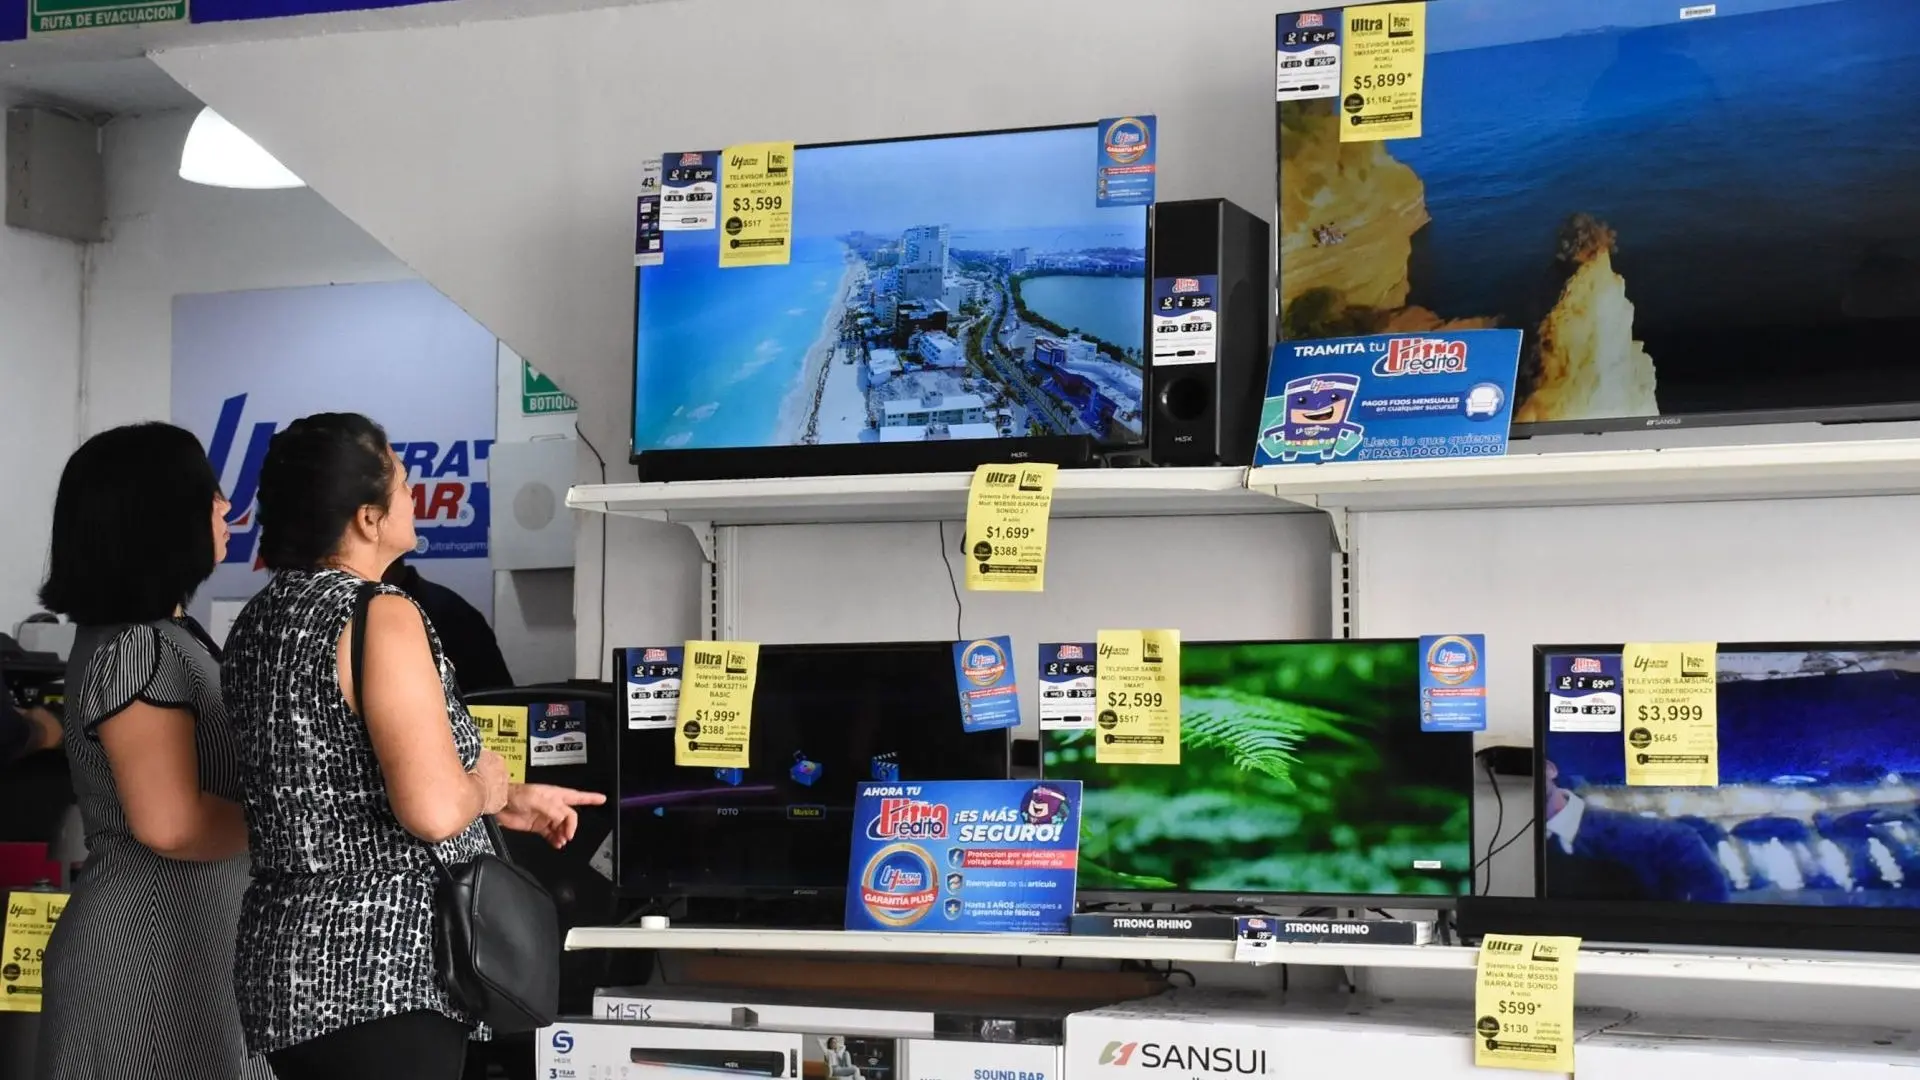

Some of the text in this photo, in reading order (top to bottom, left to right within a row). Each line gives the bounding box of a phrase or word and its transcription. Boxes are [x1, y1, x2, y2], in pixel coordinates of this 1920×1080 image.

[40, 15, 72, 30] RUTA
[76, 13, 93, 27] DE
[1351, 18, 1383, 32] Ultra
[1366, 95, 1392, 105] $1,162
[641, 177, 655, 188] 43
[733, 196, 782, 213] $3,599
[743, 220, 761, 228] $517
[1294, 342, 1385, 358] TRAMITA tu
[1388, 338, 1468, 373] Ultra
[1412, 397, 1460, 405] MENSUALES
[1425, 403, 1458, 411] sucursal
[1362, 433, 1501, 448] Lleva lo que quieras
[1372, 447, 1409, 458] PAGA
[1411, 446, 1448, 456] POCO
[1449, 445, 1459, 455] A
[1463, 443, 1505, 454] POCO!
[985, 472, 1017, 483] Ultra
[994, 546, 1018, 556] $388
[694, 651, 722, 665] Ultra
[1108, 691, 1163, 709] $2,599
[1119, 715, 1139, 723] $517
[1638, 705, 1703, 723] $3,999
[702, 725, 724, 735] $388
[1654, 733, 1677, 743] $645
[863, 786, 921, 797] AHORA TU
[717, 808, 739, 816] FOTO
[880, 798, 949, 838] Ultra
[953, 806, 1020, 825] ¡ES MÁS
[958, 823, 1064, 842] SEGURO!
[864, 893, 935, 905] GARANTÍA PLUS
[992, 900, 1014, 908] AÑOS
[1113, 918, 1192, 930] STRONG RHINO
[1284, 922, 1370, 935] STRONG RHINO
[1487, 940, 1523, 952] Ultra
[1503, 1023, 1529, 1033] $130
[1141, 1043, 1267, 1075] SANSUI
[549, 1068, 558, 1080] 3
[973, 1069, 1045, 1080] SOUND BAR
